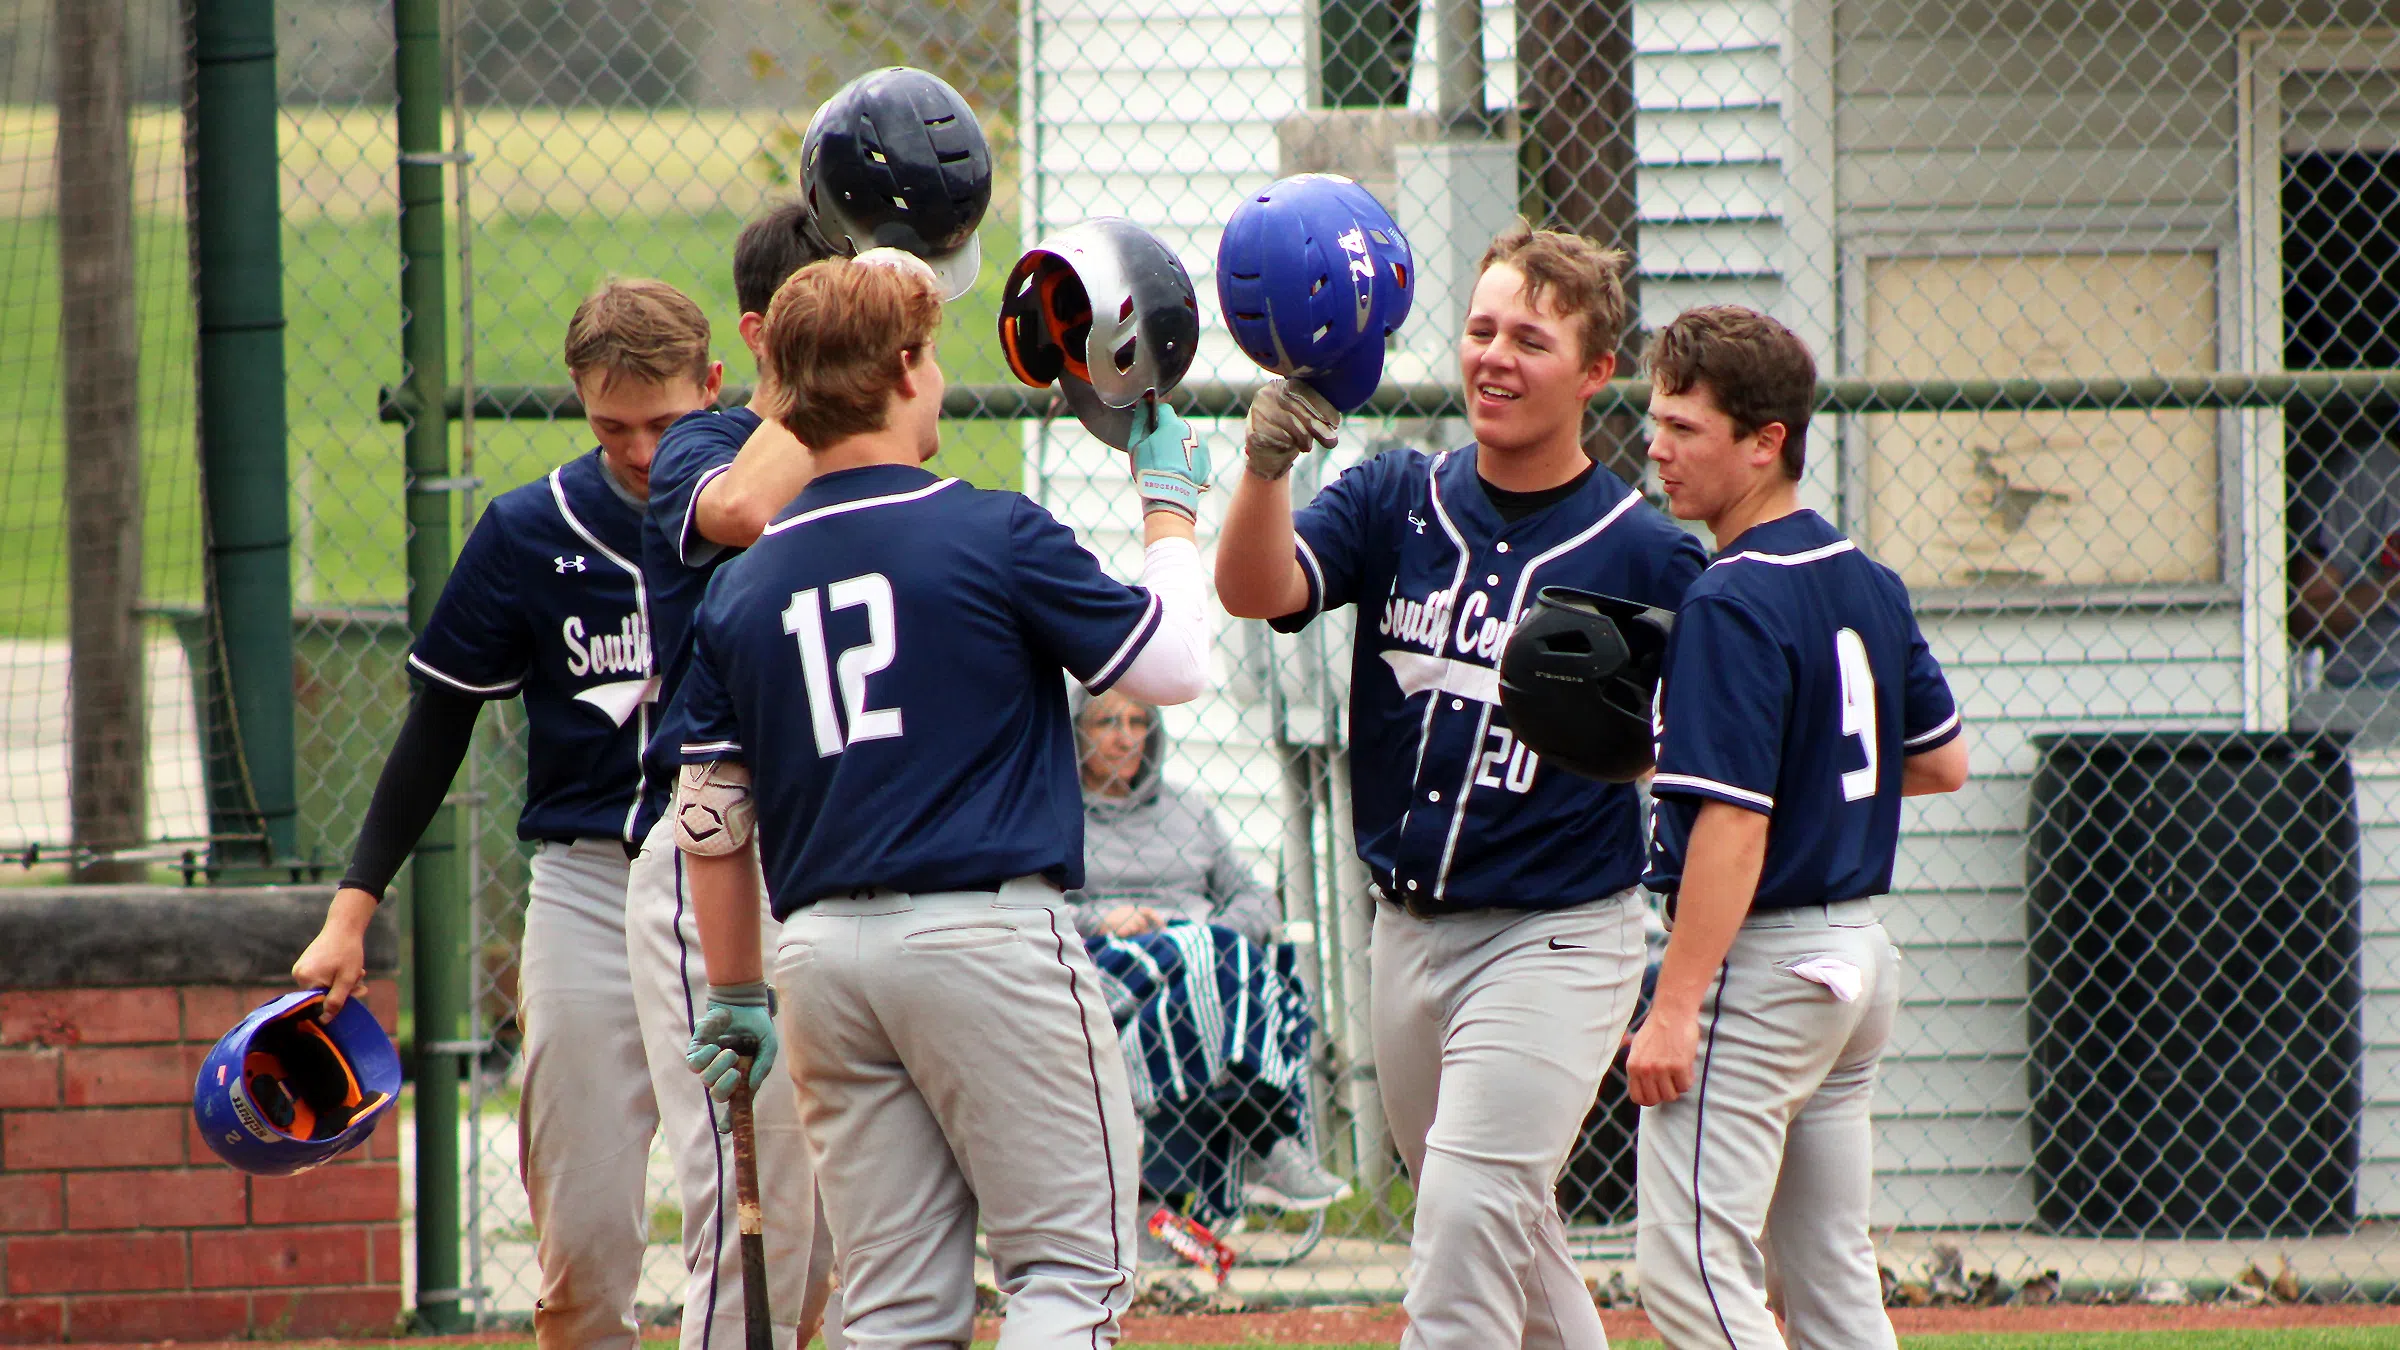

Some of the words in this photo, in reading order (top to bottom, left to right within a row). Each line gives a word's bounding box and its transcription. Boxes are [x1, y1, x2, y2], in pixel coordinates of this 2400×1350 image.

[562, 612, 653, 677] South
[1380, 575, 1450, 650] South
[781, 572, 904, 759] 12
[1474, 723, 1540, 795] 20
